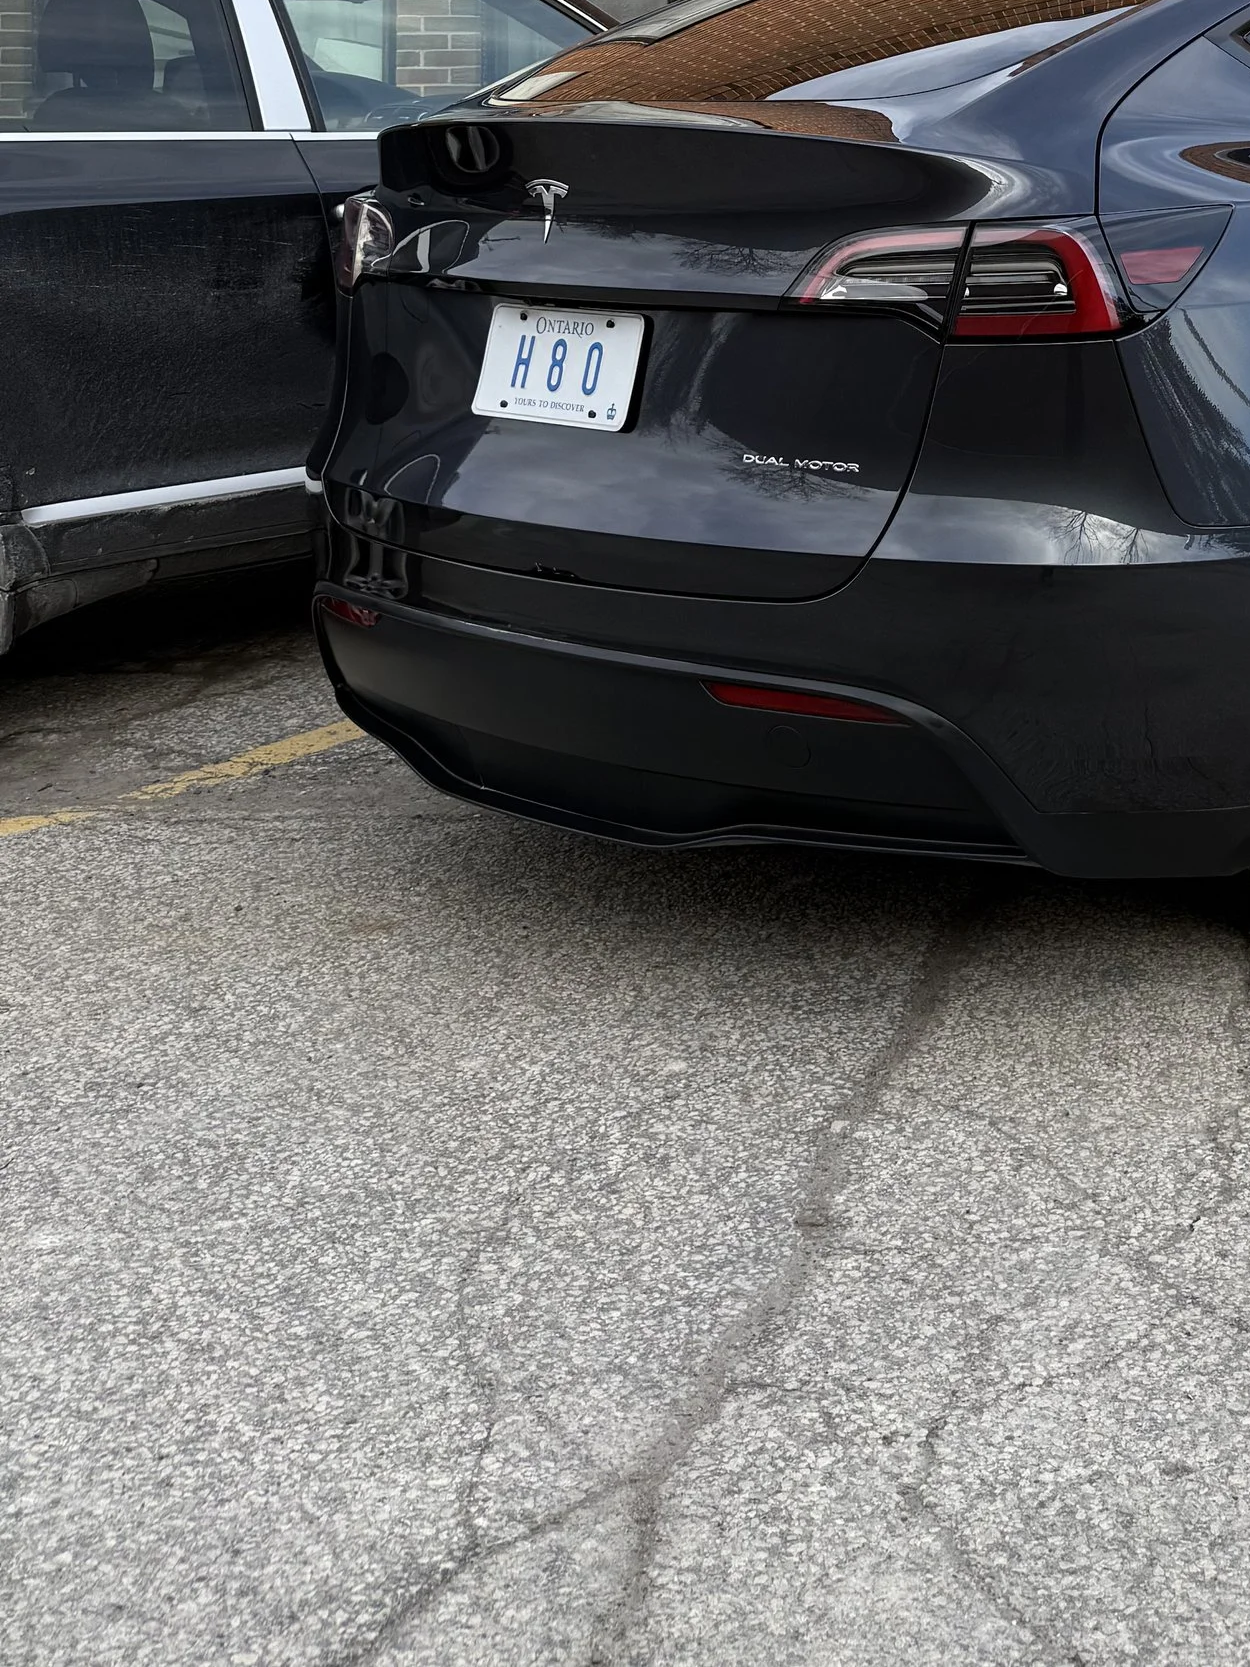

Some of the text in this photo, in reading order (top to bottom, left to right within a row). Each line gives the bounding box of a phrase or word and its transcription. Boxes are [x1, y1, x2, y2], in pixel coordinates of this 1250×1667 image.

[514, 397, 585, 413] YOURS TO DISCOVER
[743, 454, 860, 473] DUAL MOTOR
